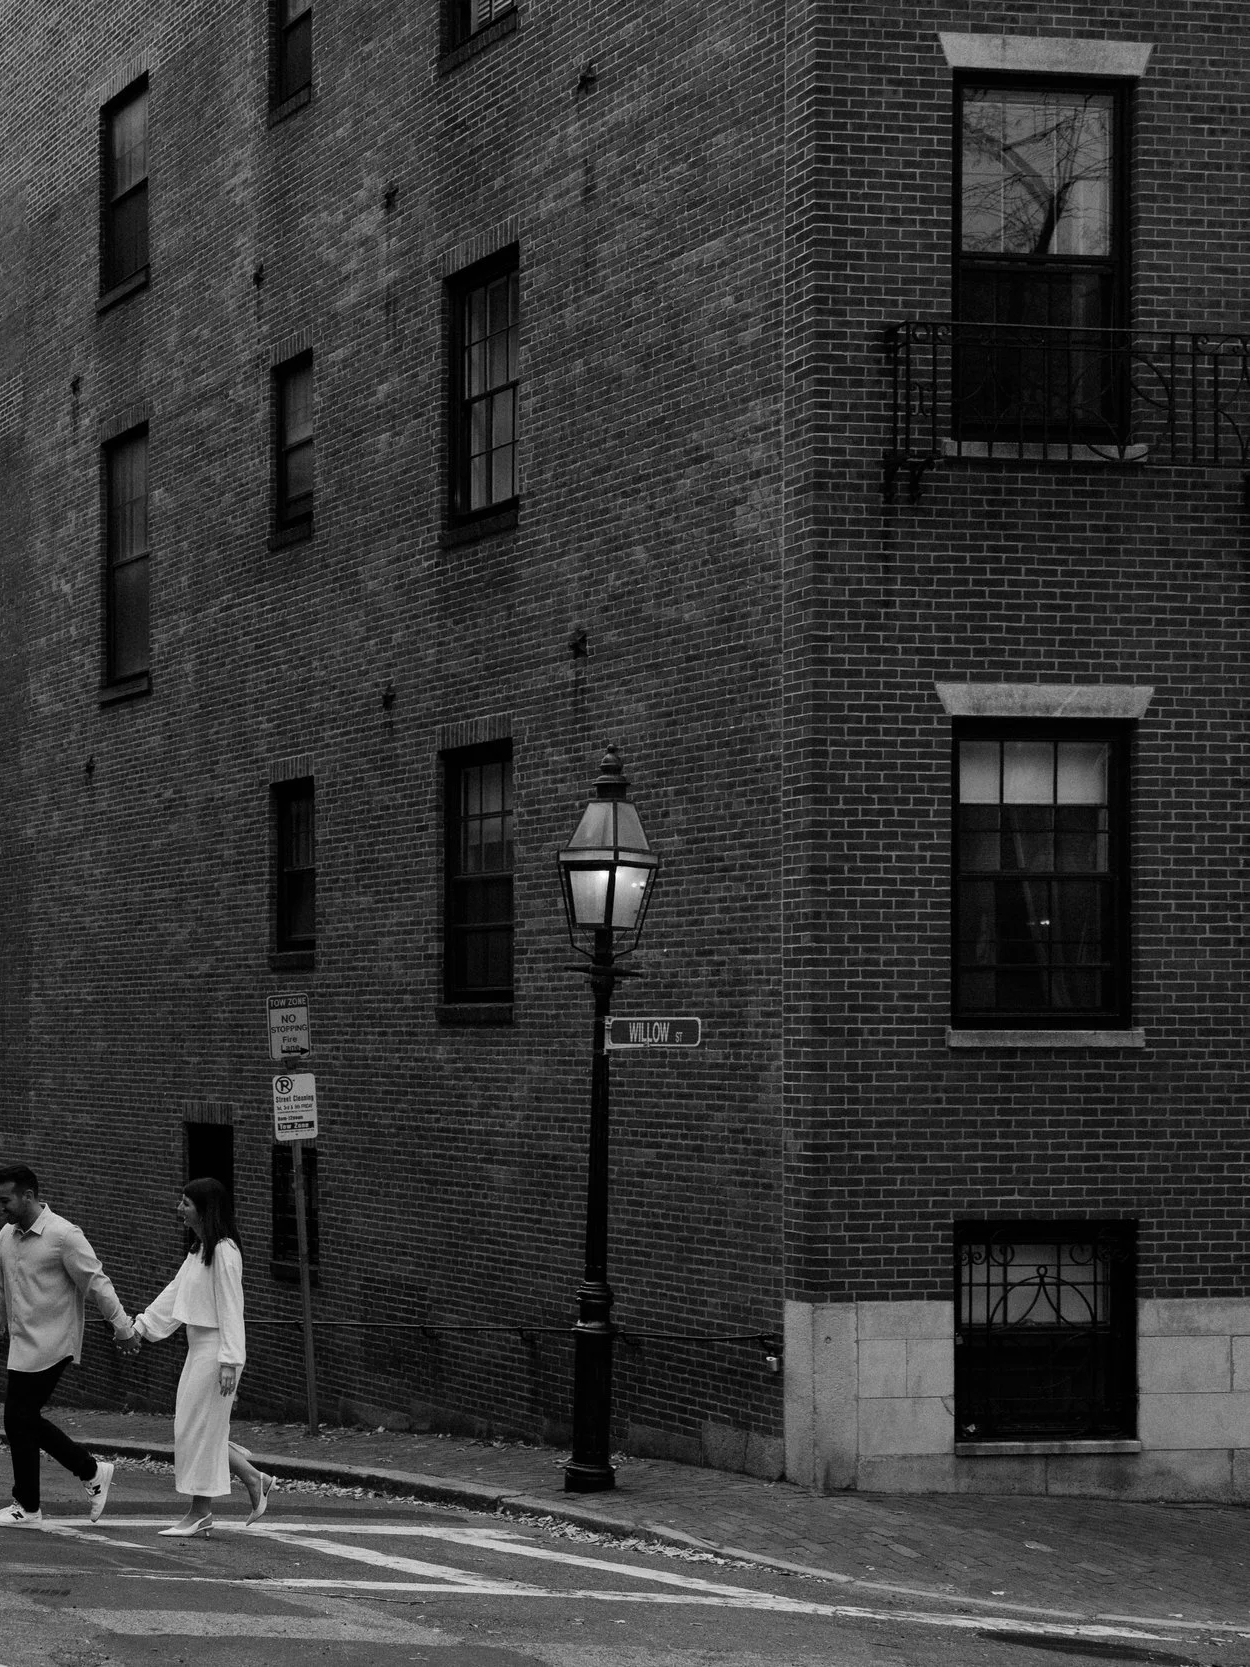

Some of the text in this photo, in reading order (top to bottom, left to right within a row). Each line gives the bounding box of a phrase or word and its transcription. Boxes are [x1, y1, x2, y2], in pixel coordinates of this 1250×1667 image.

[270, 997, 307, 1007] TOW ZONE
[281, 1014, 296, 1024] NO
[270, 1024, 307, 1034] STOPPING
[629, 1022, 683, 1043] WILLOW ST
[275, 1094, 314, 1103] Street Cleaning
[11, 1511, 24, 1519] N
